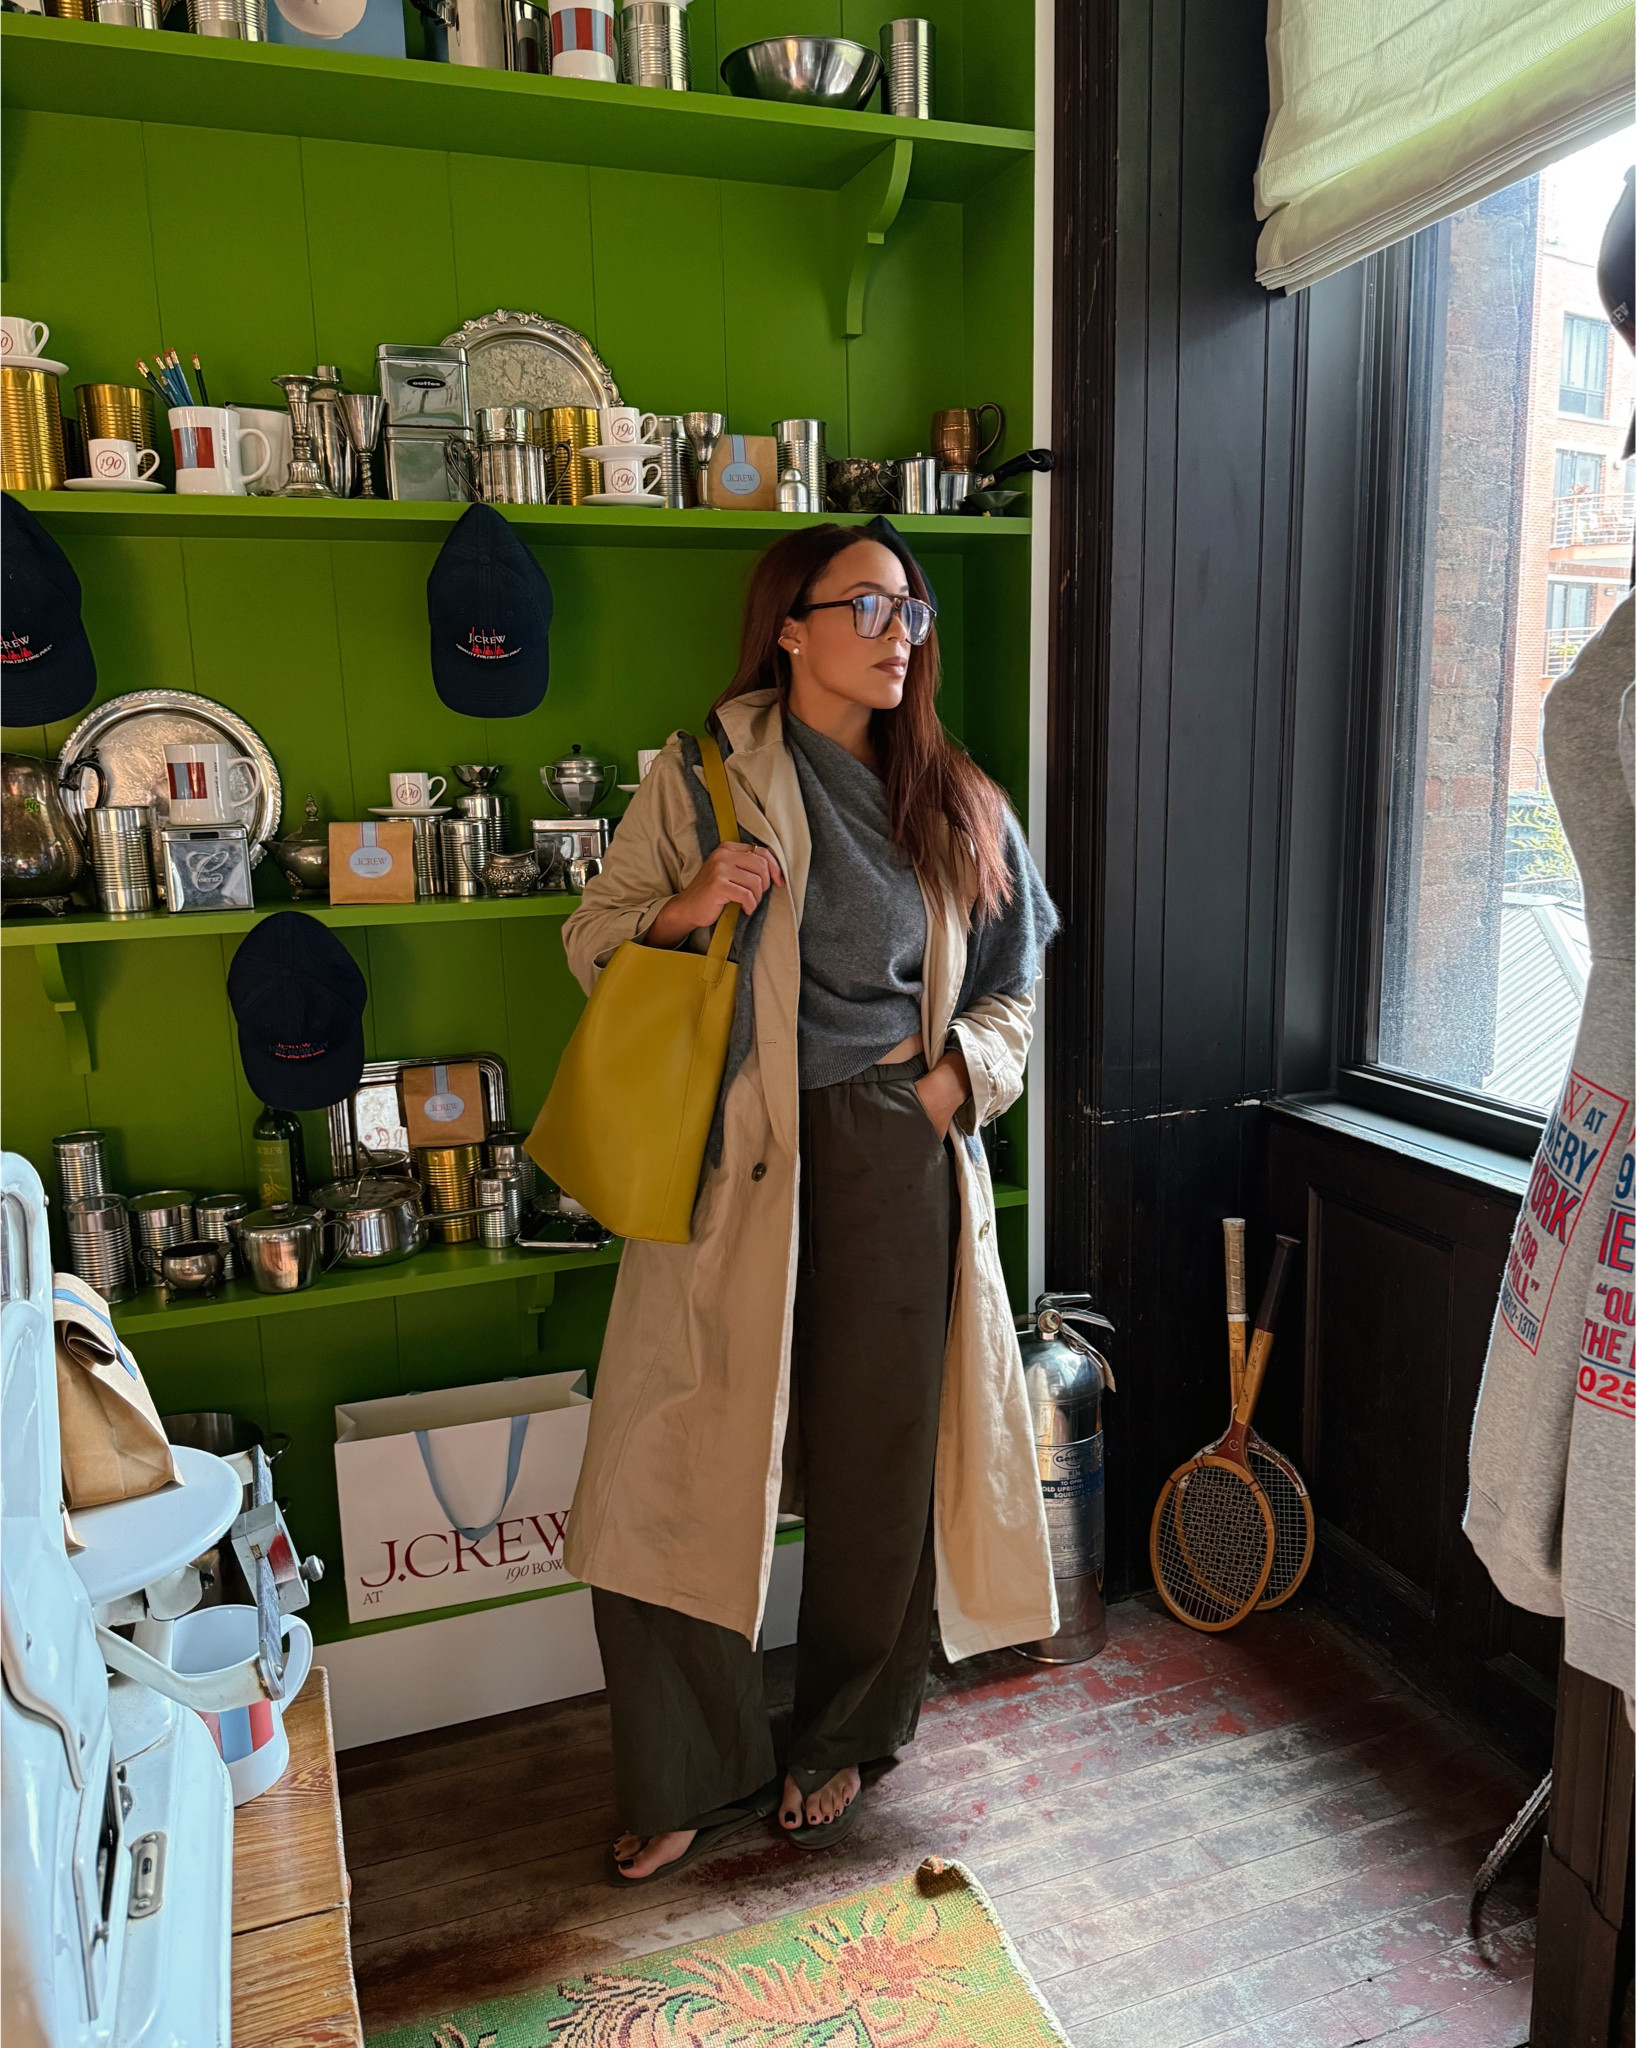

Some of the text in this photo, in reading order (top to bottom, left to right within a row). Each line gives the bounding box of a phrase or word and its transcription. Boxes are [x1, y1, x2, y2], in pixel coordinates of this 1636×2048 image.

[616, 423, 634, 438] 190
[100, 456, 122, 471] 190
[615, 473, 634, 487] 190
[400, 788, 419, 800] 190
[1583, 1106, 1608, 1135] AT
[1519, 1222, 1539, 1270] FOR
[362, 1590, 384, 1606] AT
[506, 1564, 530, 1584] 190
